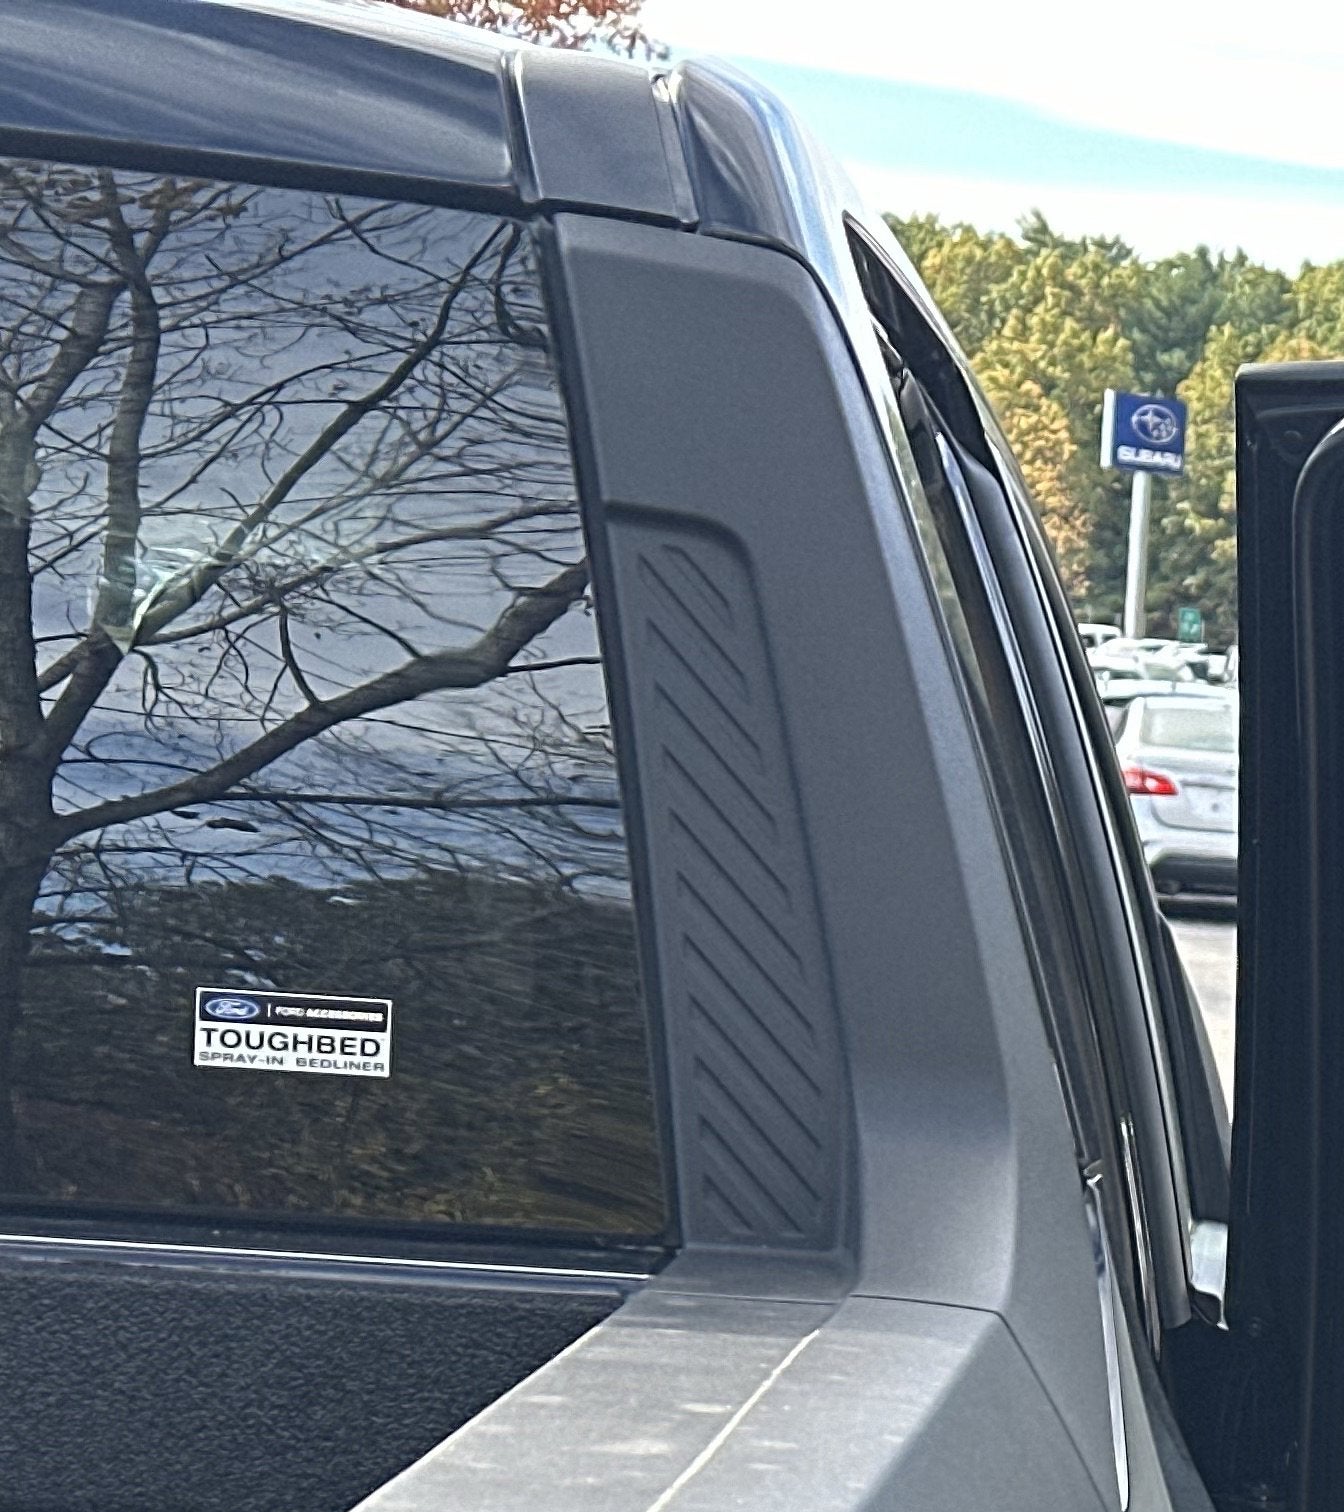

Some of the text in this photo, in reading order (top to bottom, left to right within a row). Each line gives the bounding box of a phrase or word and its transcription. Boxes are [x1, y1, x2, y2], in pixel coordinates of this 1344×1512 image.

[200, 1027, 381, 1057] TOUGHBED
[199, 1051, 385, 1073] SPRAY-IN BEDLINER
